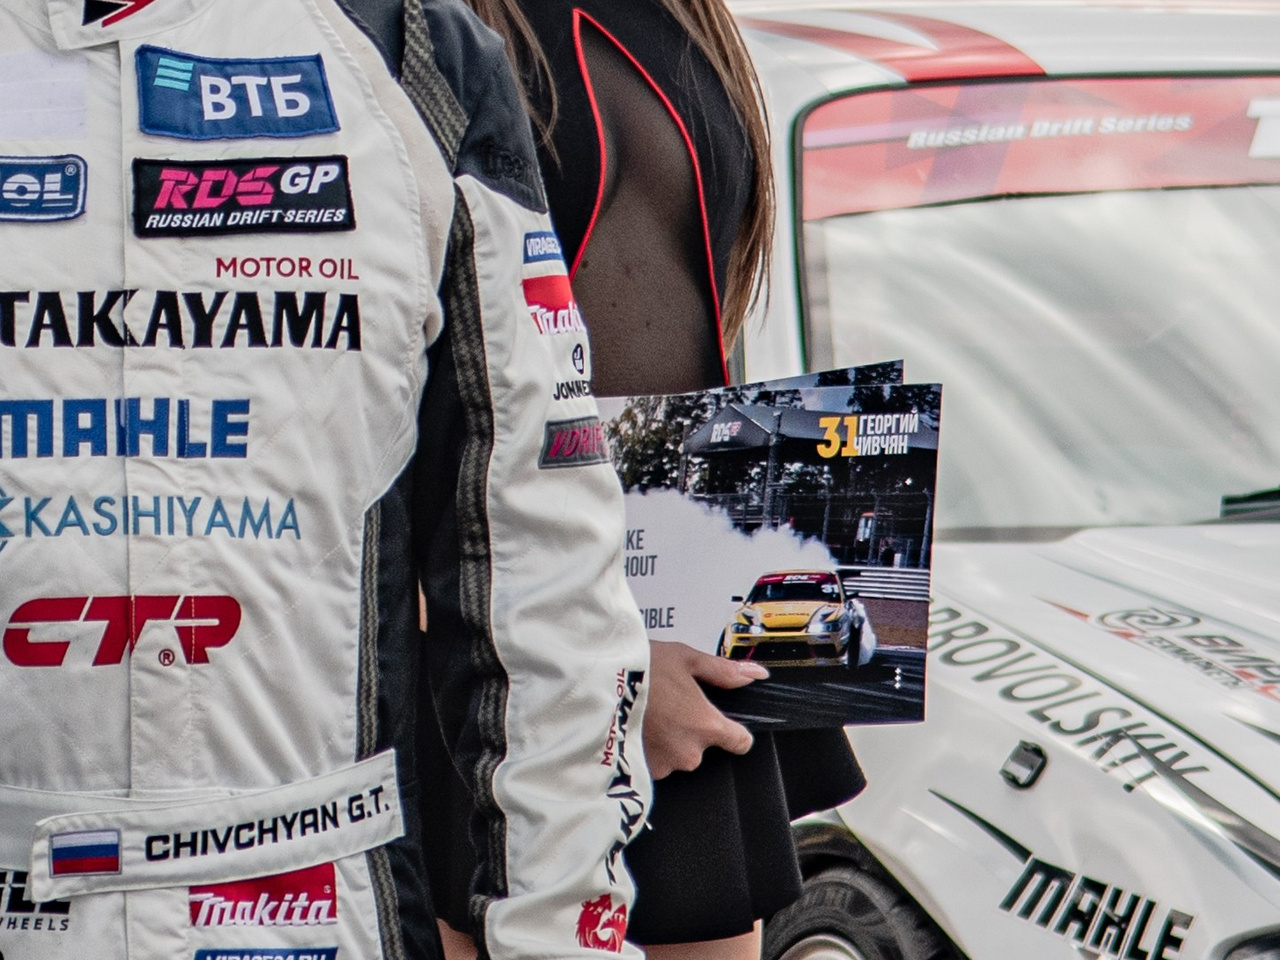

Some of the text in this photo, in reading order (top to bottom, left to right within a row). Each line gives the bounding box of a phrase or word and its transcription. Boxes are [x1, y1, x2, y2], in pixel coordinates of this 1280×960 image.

[907, 121, 1027, 149] Russian
[1029, 117, 1096, 139] Drift
[1098, 113, 1194, 134] Series
[153, 164, 340, 209] RDS GP
[145, 208, 346, 229] RUSSIAN DRIFT SERIES
[216, 256, 360, 280] MOTOR OIL
[816, 416, 858, 459] 31
[858, 407, 919, 435] ГЕОРГИЙ
[853, 435, 908, 457] ЧИВЧЯН
[144, 785, 391, 862] CHIVCHYAN G.T.
[998, 856, 1195, 960] MAHLE
